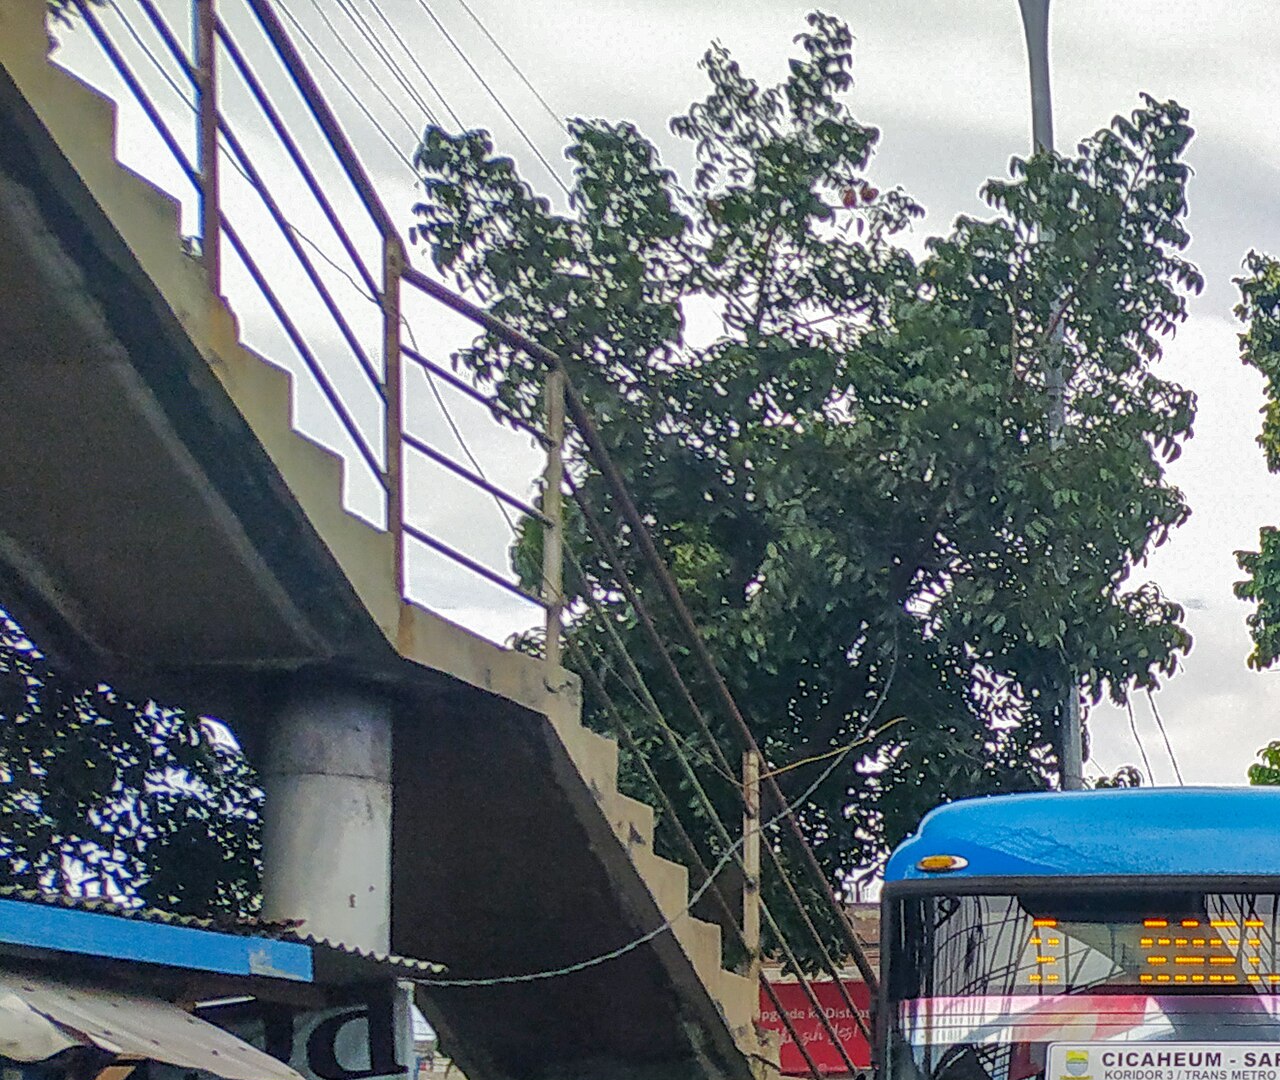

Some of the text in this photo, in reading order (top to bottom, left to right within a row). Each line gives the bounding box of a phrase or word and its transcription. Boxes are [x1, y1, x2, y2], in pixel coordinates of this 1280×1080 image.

[1101, 1051, 1222, 1068] CICAHEUM
[1104, 1070, 1163, 1080] KORIDOR
[1166, 1070, 1174, 1080] 3
[1185, 1070, 1228, 1080] TRANS
[1231, 1070, 1277, 1080] METRO
